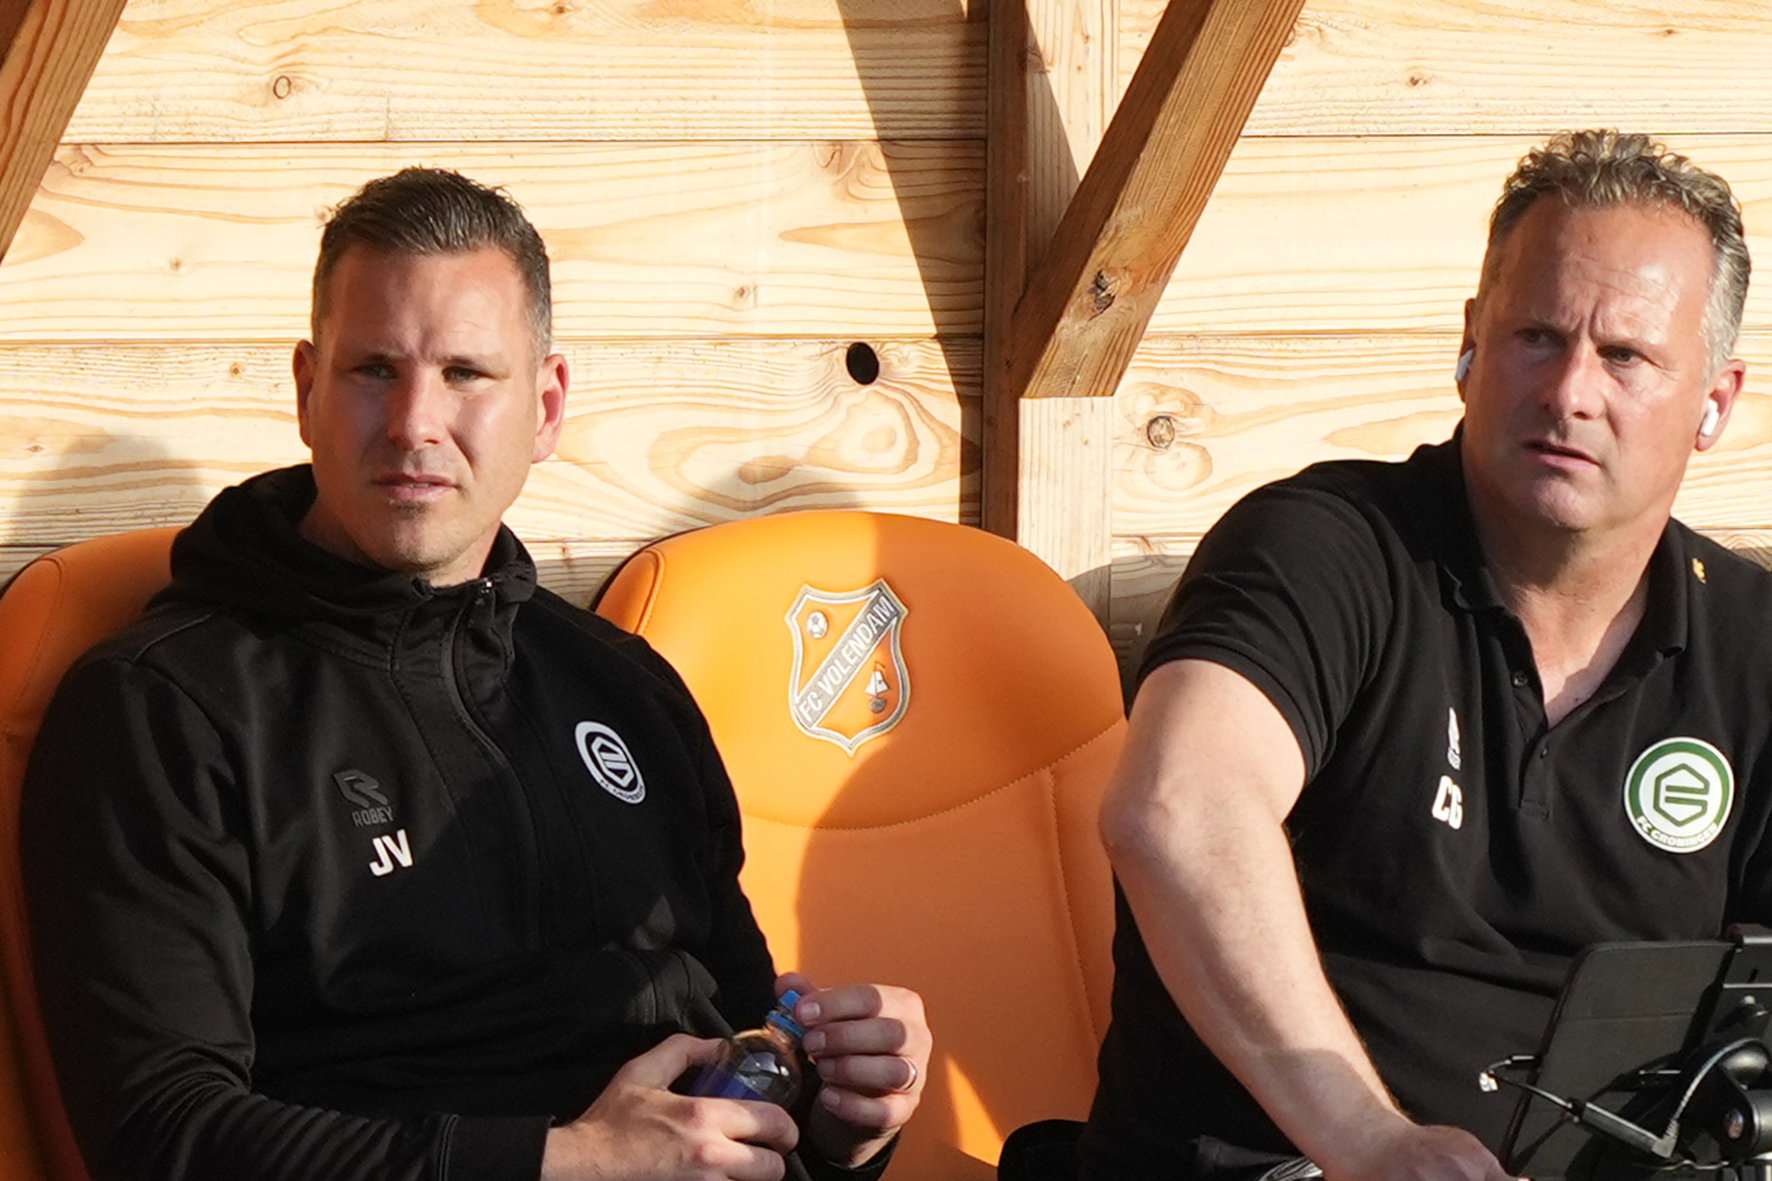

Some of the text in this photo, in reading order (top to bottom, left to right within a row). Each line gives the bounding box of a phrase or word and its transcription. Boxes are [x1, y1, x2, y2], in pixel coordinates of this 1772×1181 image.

[799, 595, 895, 723] FC VOLENDAM
[351, 806, 394, 828] ROBEY
[369, 828, 413, 877] JV
